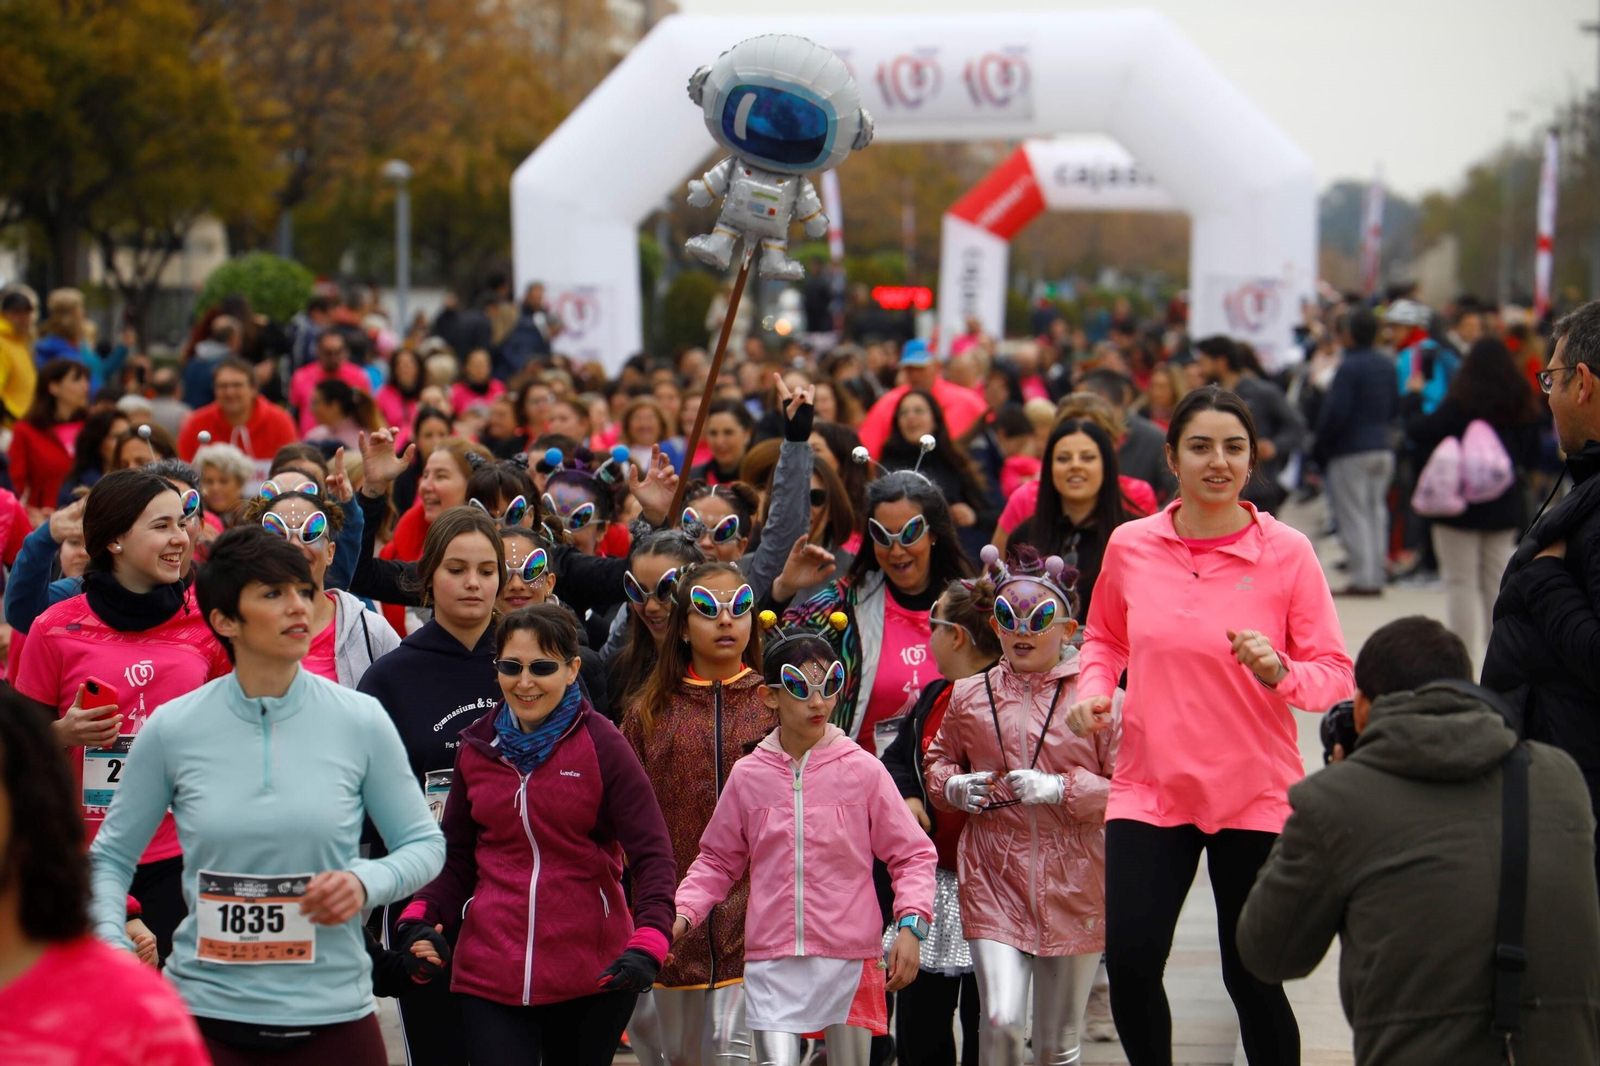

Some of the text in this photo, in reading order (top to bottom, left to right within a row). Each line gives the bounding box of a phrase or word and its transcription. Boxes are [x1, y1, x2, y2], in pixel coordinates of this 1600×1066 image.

[433, 703, 477, 732] Gymnasium
[476, 697, 486, 709] &
[218, 903, 285, 934] 1835
